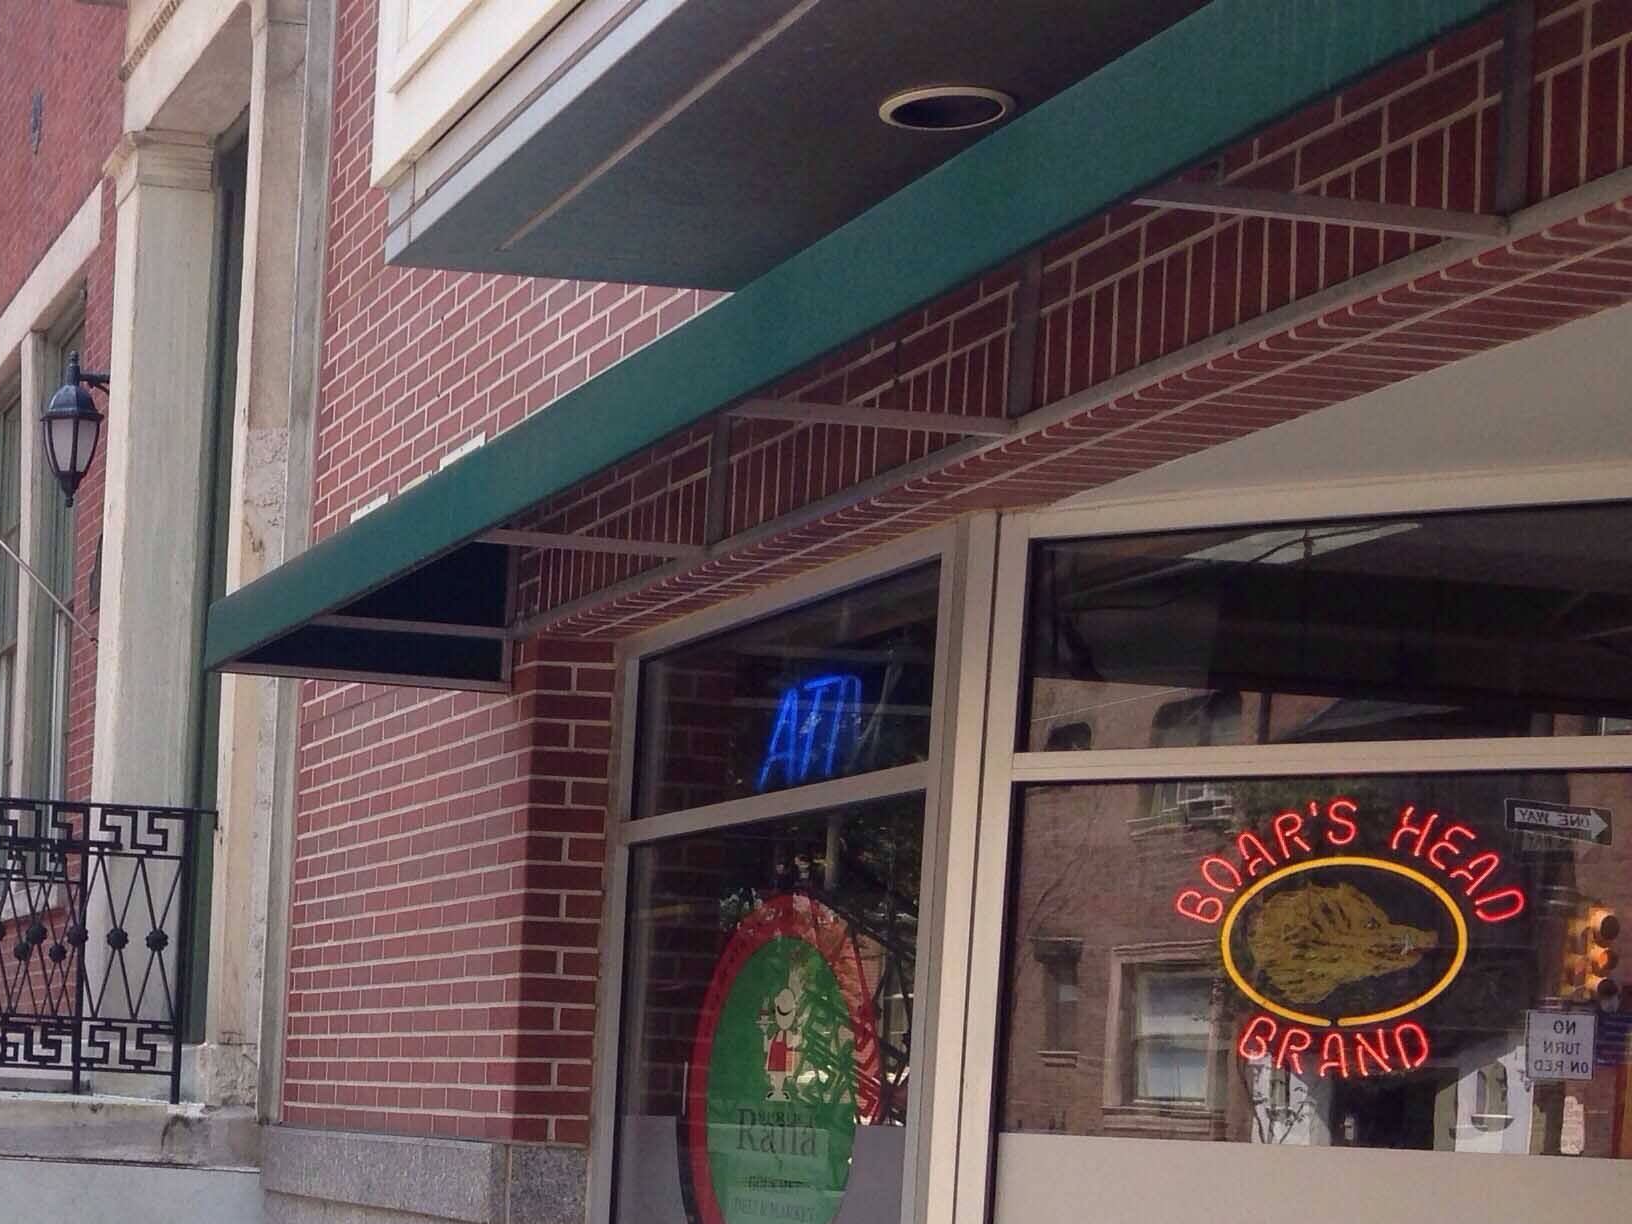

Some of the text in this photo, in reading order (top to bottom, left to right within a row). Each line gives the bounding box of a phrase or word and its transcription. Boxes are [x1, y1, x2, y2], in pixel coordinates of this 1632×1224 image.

[1175, 799, 1526, 925] BOAR'S HEAD
[1238, 1014, 1432, 1079] GRAND
